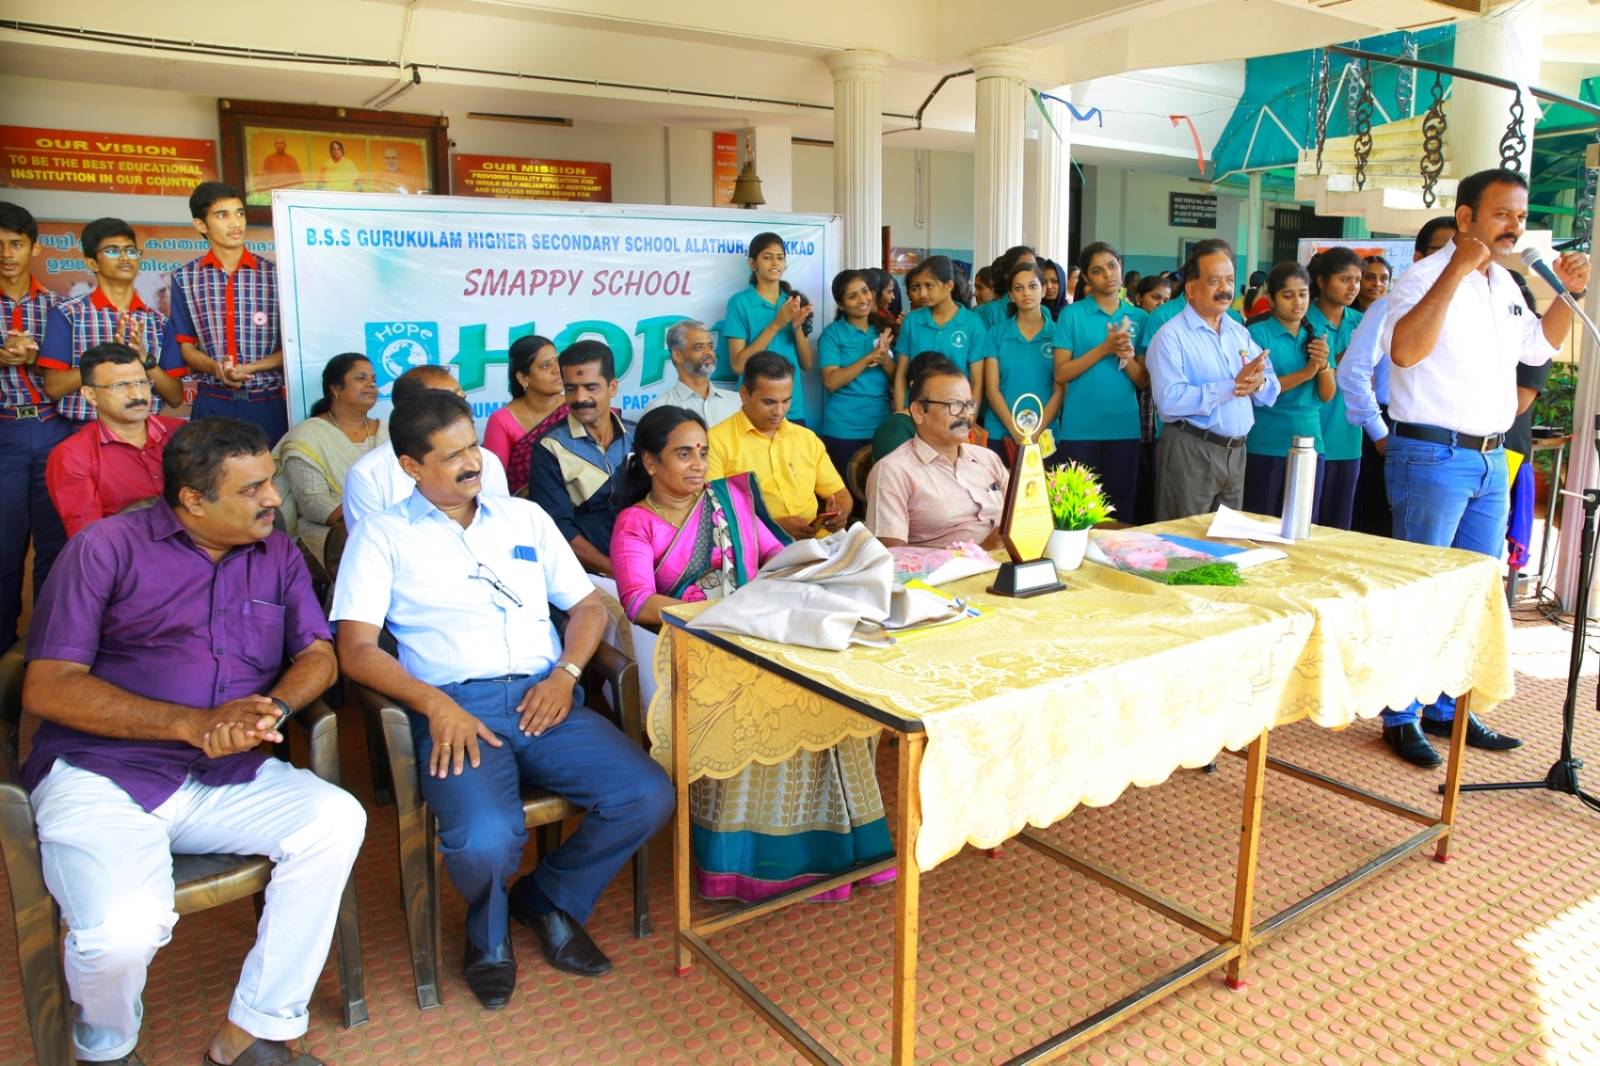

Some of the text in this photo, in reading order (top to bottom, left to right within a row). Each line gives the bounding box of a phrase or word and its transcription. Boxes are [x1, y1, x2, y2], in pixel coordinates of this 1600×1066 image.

[36, 138, 177, 155] OUR VISION
[9, 154, 203, 175] TO BE THE BEST EDUCATIONAL
[482, 162, 586, 175] OUR MISSION
[11, 169, 202, 188] INSTITUTION IN OUR COUNTRY
[306, 228, 350, 246] B.S.S
[357, 229, 462, 249] GURUKULAM
[468, 233, 527, 249] HIGHER
[532, 234, 620, 251] SECONDARY
[625, 236, 681, 253] SCHOOL
[685, 237, 749, 258] ALATHUR,
[463, 268, 691, 296] SMAPPY SCHOOL
